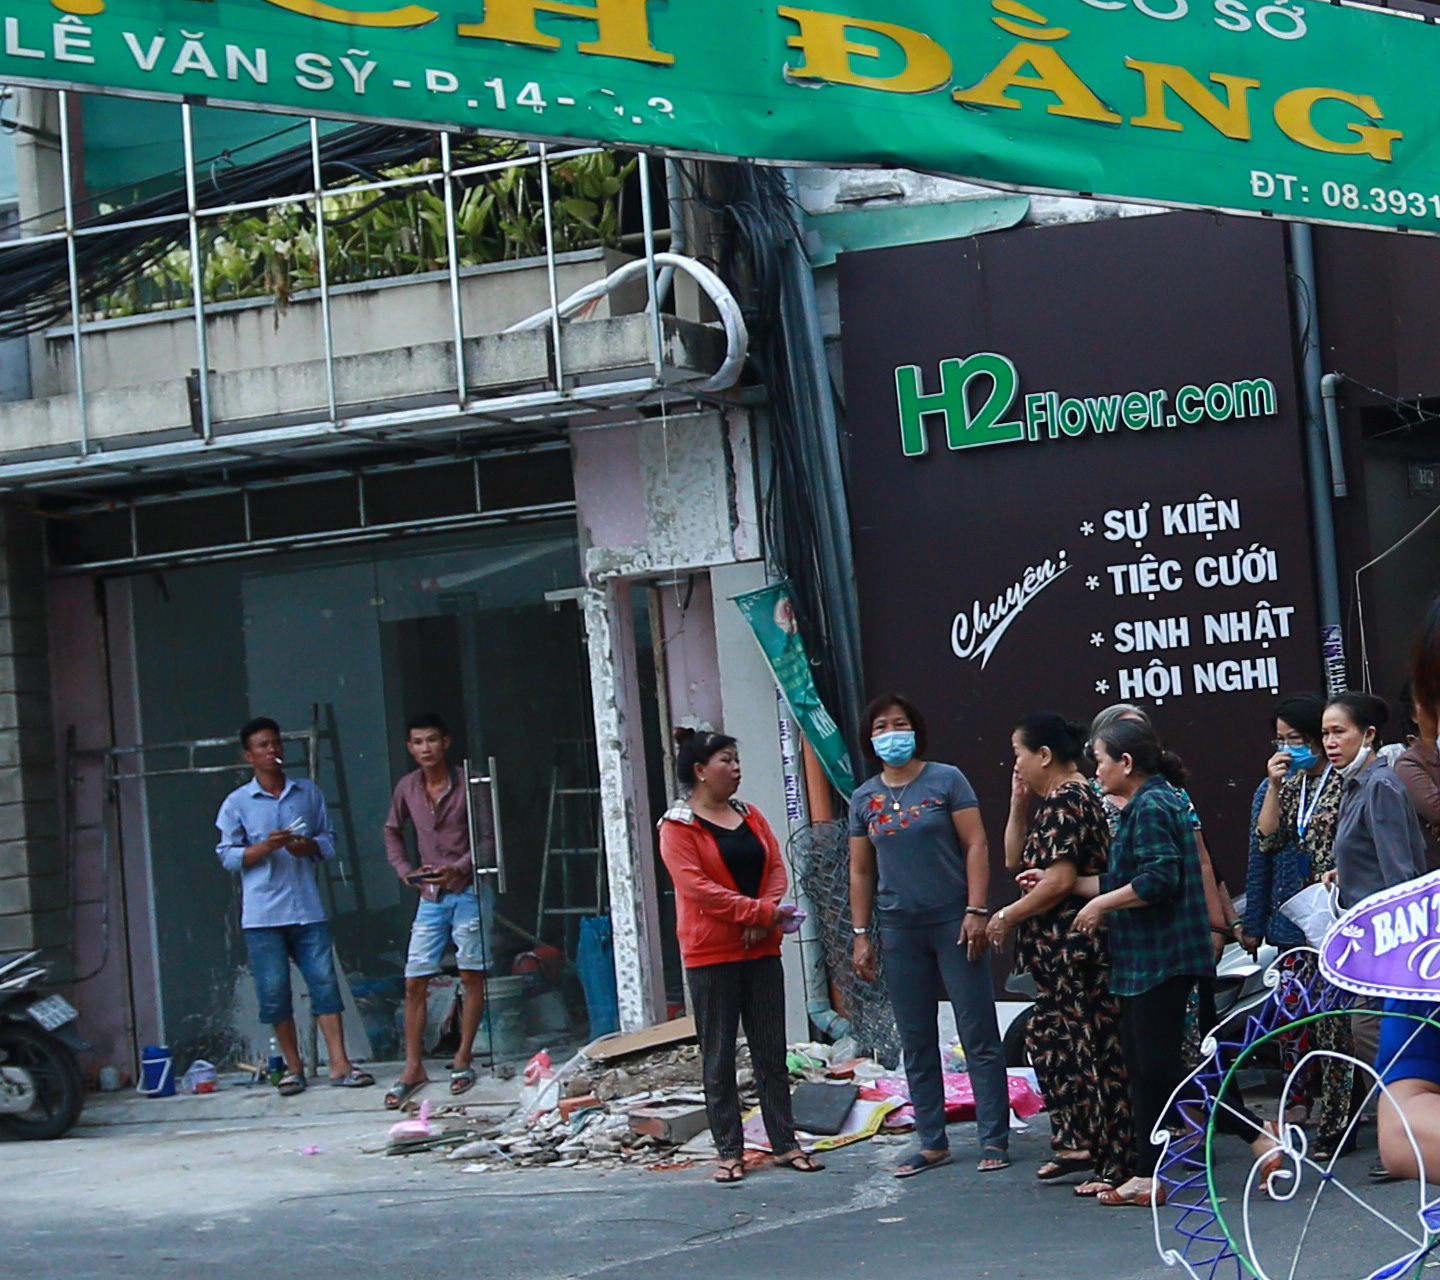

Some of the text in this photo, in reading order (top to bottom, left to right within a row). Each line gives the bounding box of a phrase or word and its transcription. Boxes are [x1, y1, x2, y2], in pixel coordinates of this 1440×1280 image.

[2, 11, 95, 67] LÊ
[121, 27, 269, 91] VĂN
[1248, 169, 1313, 205] ĐT:
[1102, 492, 1242, 548] SỰ KIỆN
[1106, 542, 1280, 601] TIỆC CƯỚI
[1112, 600, 1296, 655] SINH NHẬT
[1117, 659, 1185, 707] HỘI
[1192, 655, 1281, 696] NGHỊ
[1370, 896, 1430, 958] BAN
